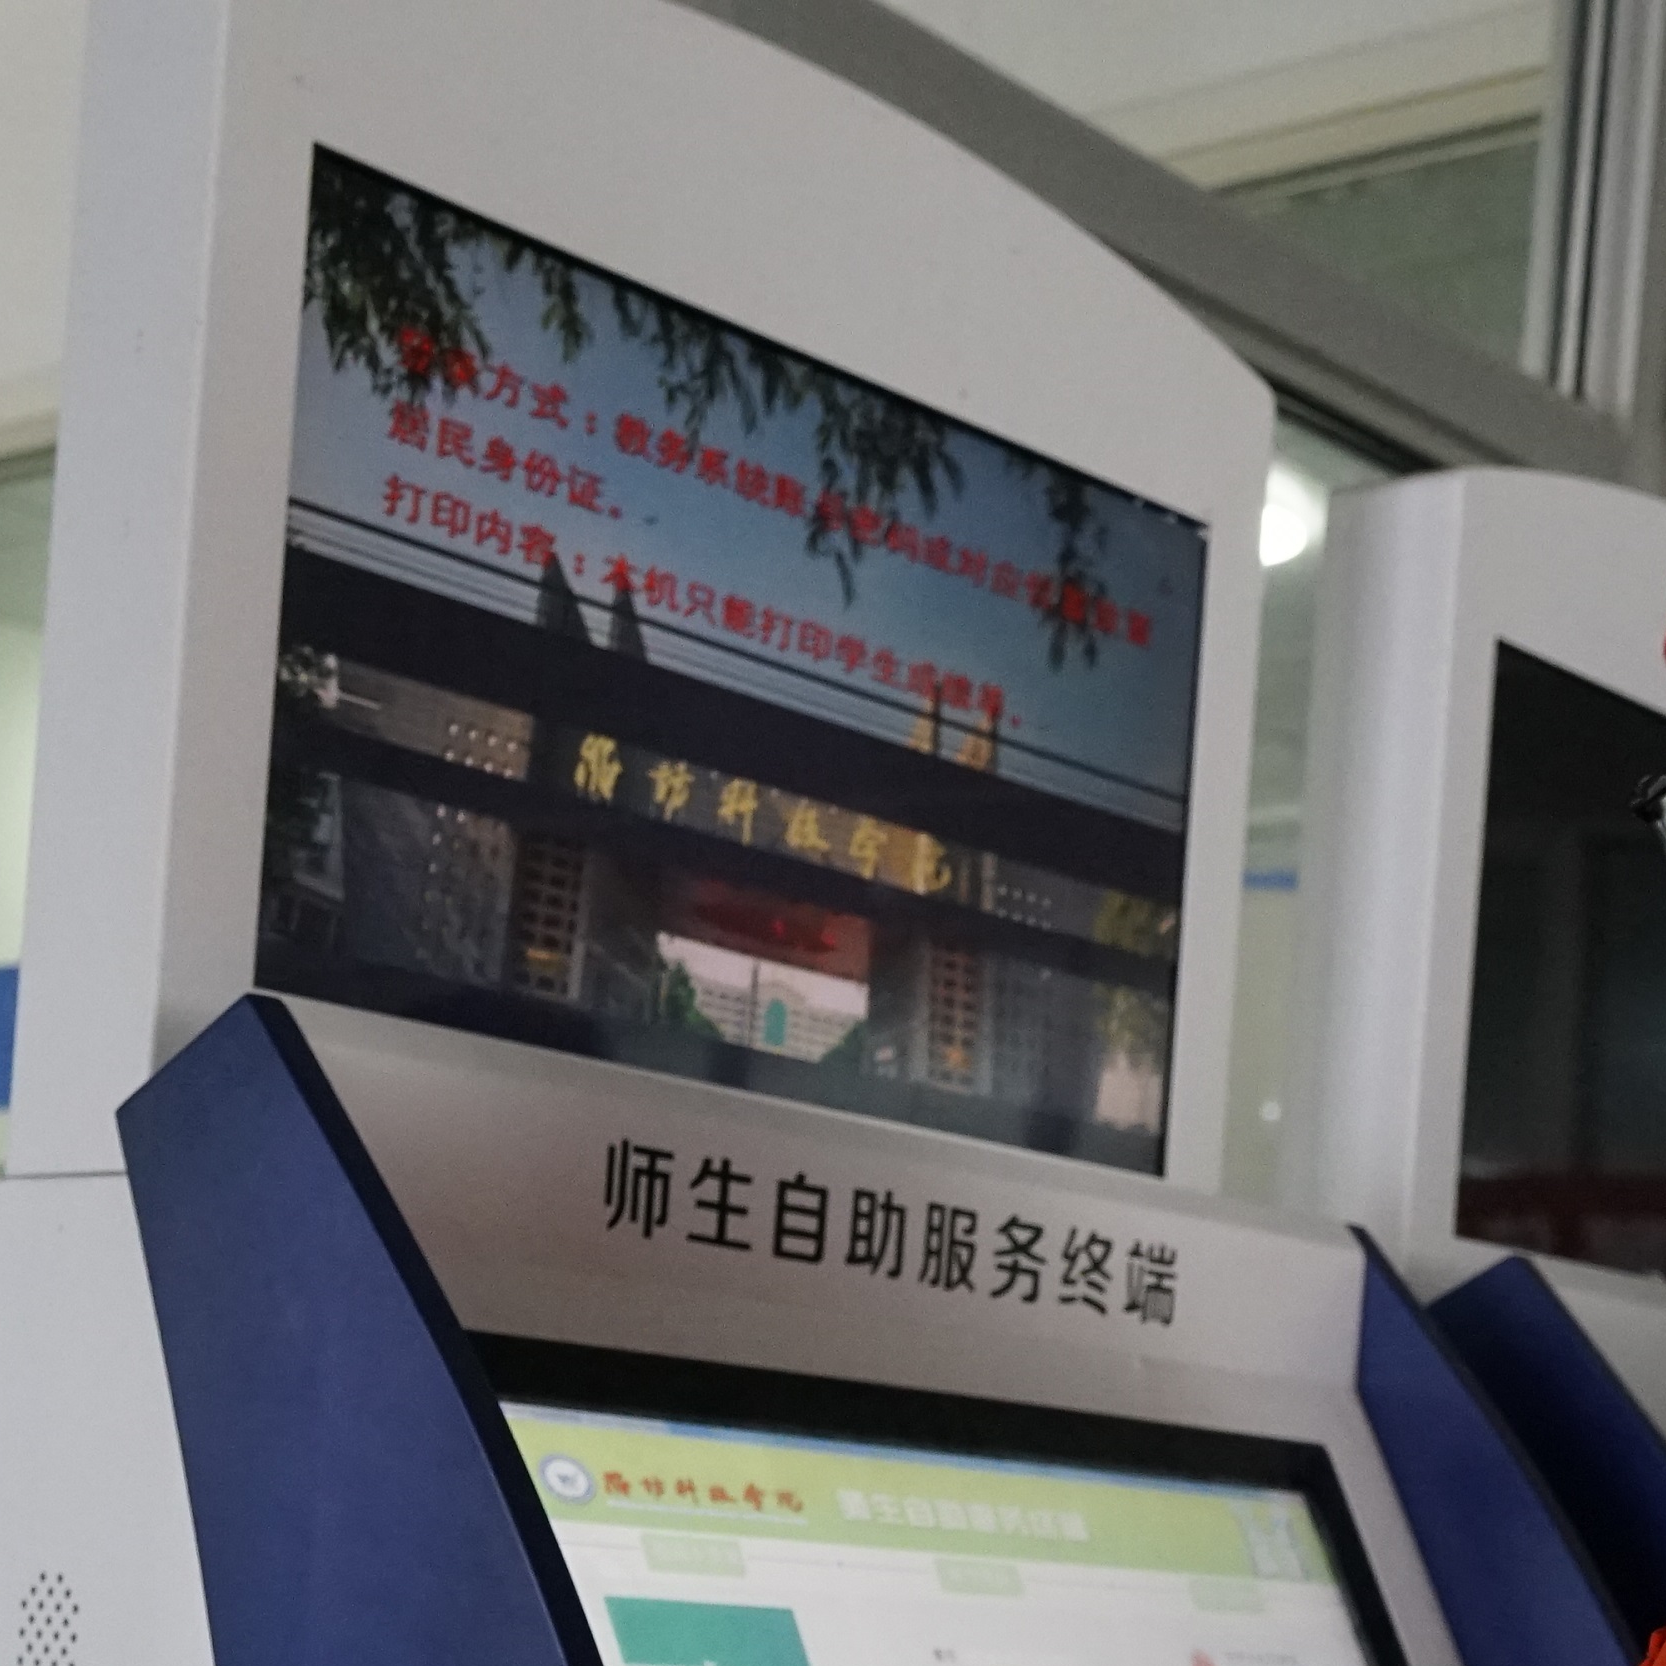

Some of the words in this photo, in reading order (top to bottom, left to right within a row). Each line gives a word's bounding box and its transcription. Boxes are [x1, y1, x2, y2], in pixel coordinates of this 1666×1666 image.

[603, 1138, 1179, 1327] 师生自助服务终端
